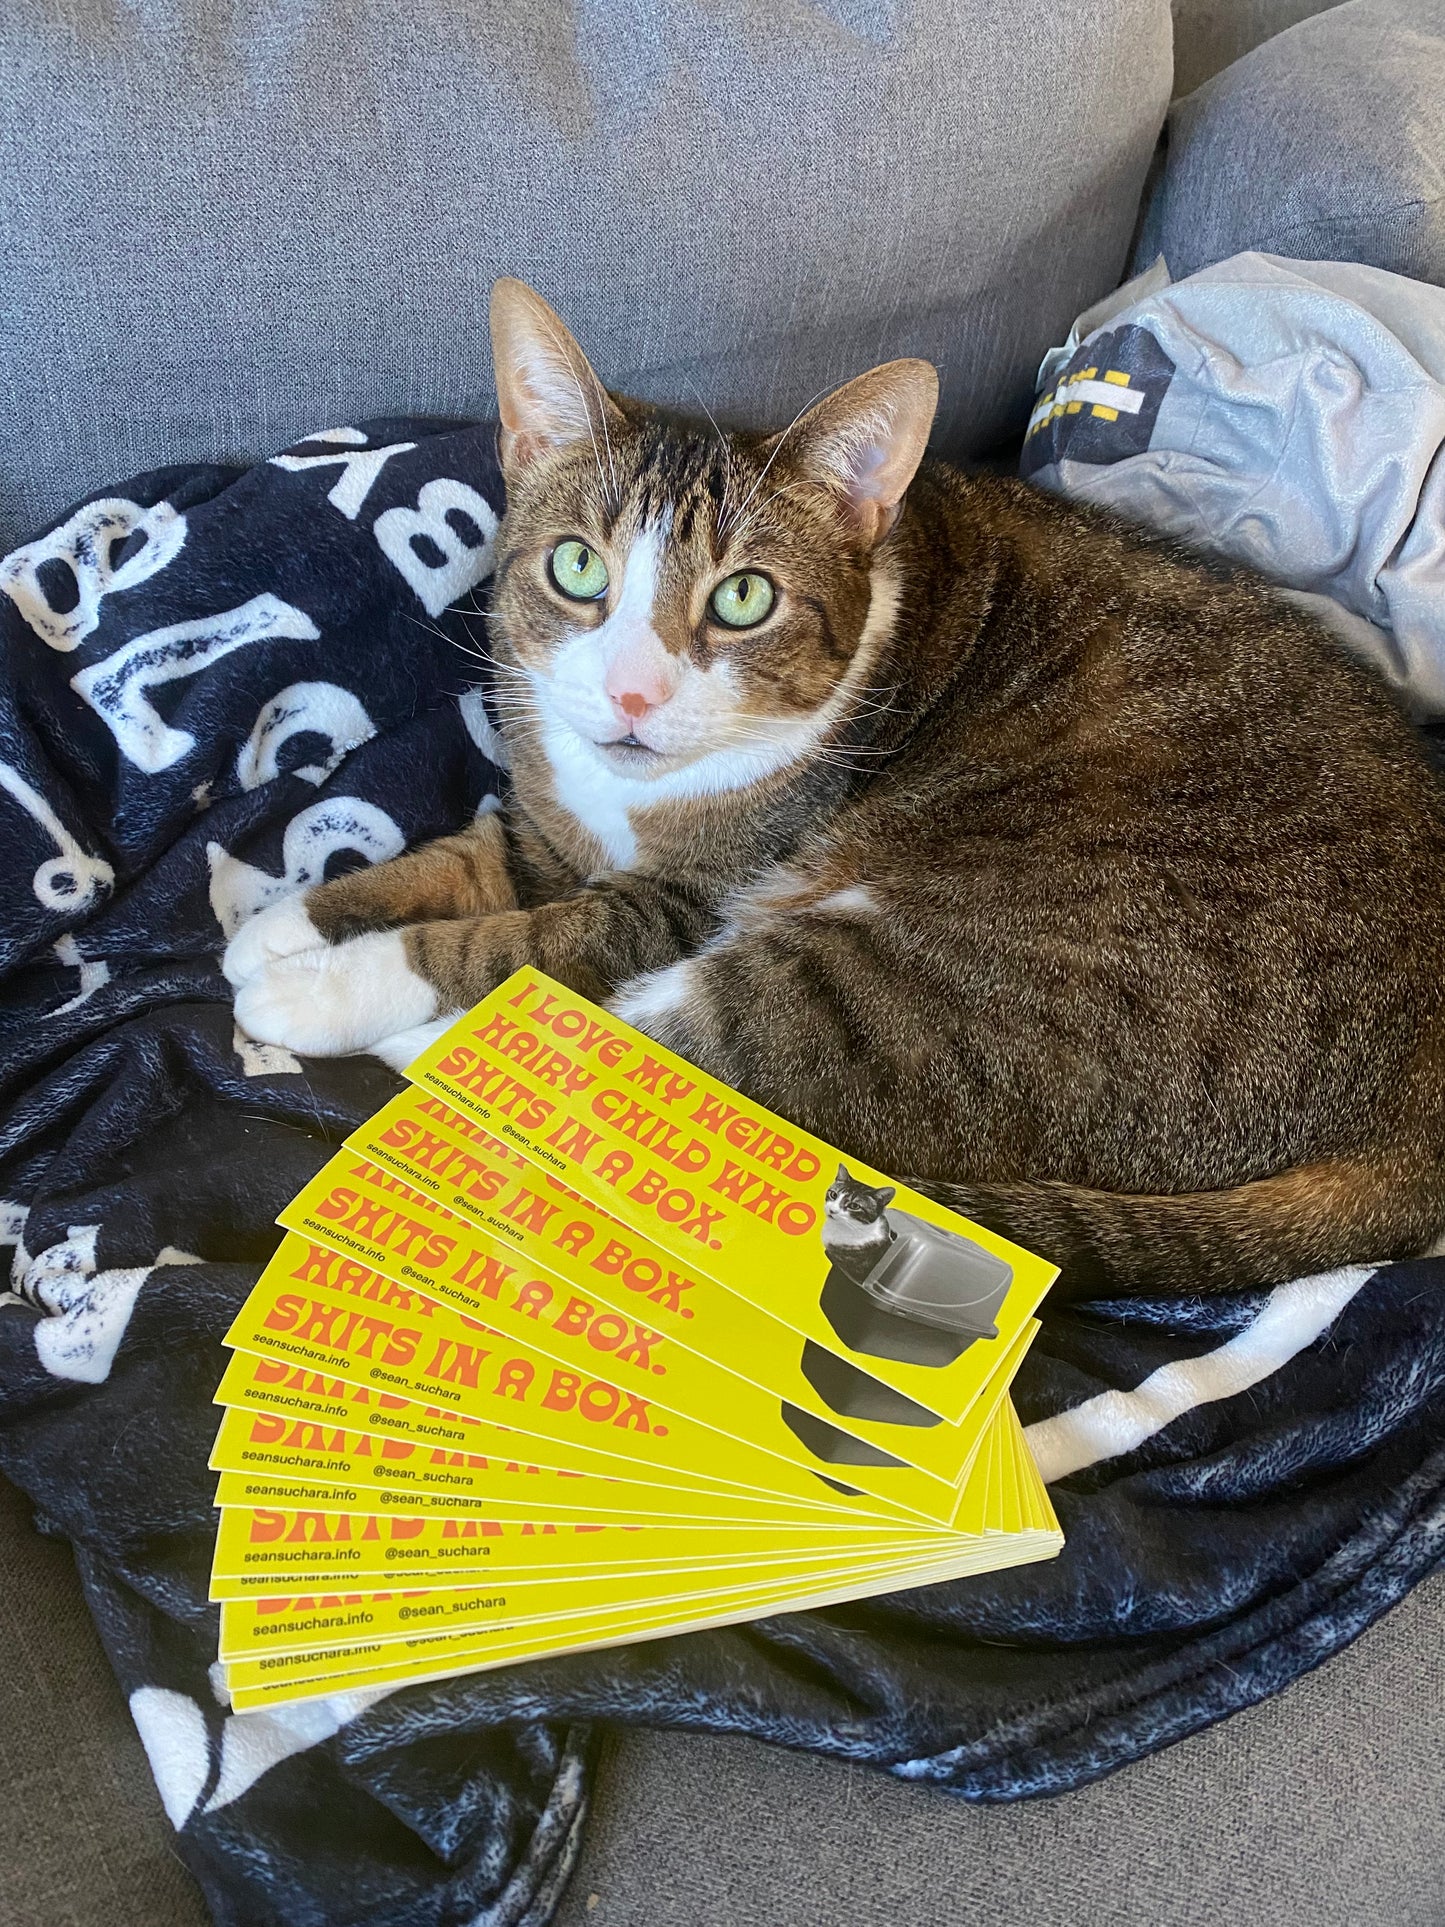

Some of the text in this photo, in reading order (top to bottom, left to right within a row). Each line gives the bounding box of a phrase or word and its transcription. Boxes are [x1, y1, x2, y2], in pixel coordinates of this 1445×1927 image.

[423, 1071, 492, 1120] seansuchara.info
[501, 1123, 568, 1171] @sean_suchara
[472, 1012, 598, 1097] HAIRY
[591, 1089, 711, 1173] CHILD
[708, 1159, 817, 1236] WHO
[508, 982, 821, 1182] I LOVE MY WEIRD
[366, 1142, 441, 1191] seansuchara.info
[453, 1195, 525, 1242] @sean_suchara
[436, 1046, 556, 1130] SHITS
[544, 1116, 605, 1163] IN
[592, 1150, 634, 1187] A
[626, 1167, 727, 1250] BOX.
[302, 1217, 481, 1309] seansuchara.info @sean_suchara
[378, 1119, 510, 1200] SHITS
[499, 1187, 563, 1236] IN
[552, 1221, 595, 1258] A
[590, 1238, 696, 1320] BOX.
[314, 1187, 458, 1269] SHITS
[450, 1249, 518, 1301] IN
[510, 1280, 554, 1321] A
[551, 1296, 667, 1376] BOX.
[243, 1387, 348, 1417] seansuchara.info
[368, 1413, 466, 1441] @sean_suchara
[252, 1332, 350, 1369] seansuchara.info
[369, 1367, 462, 1401] @sean_suchara
[263, 1294, 423, 1367] SHITS
[423, 1338, 494, 1389] IN
[492, 1358, 535, 1402] A
[540, 1369, 669, 1437] BOX.
[241, 1450, 474, 1486] seansuchara.info @sean_suchara
[245, 1483, 483, 1509] seansuchara.info @sean_suchara
[244, 1545, 490, 1563] seansuchara.info @sean_suchara
[252, 1611, 374, 1637] seansuchara.info
[398, 1596, 507, 1620] @sean_suchara
